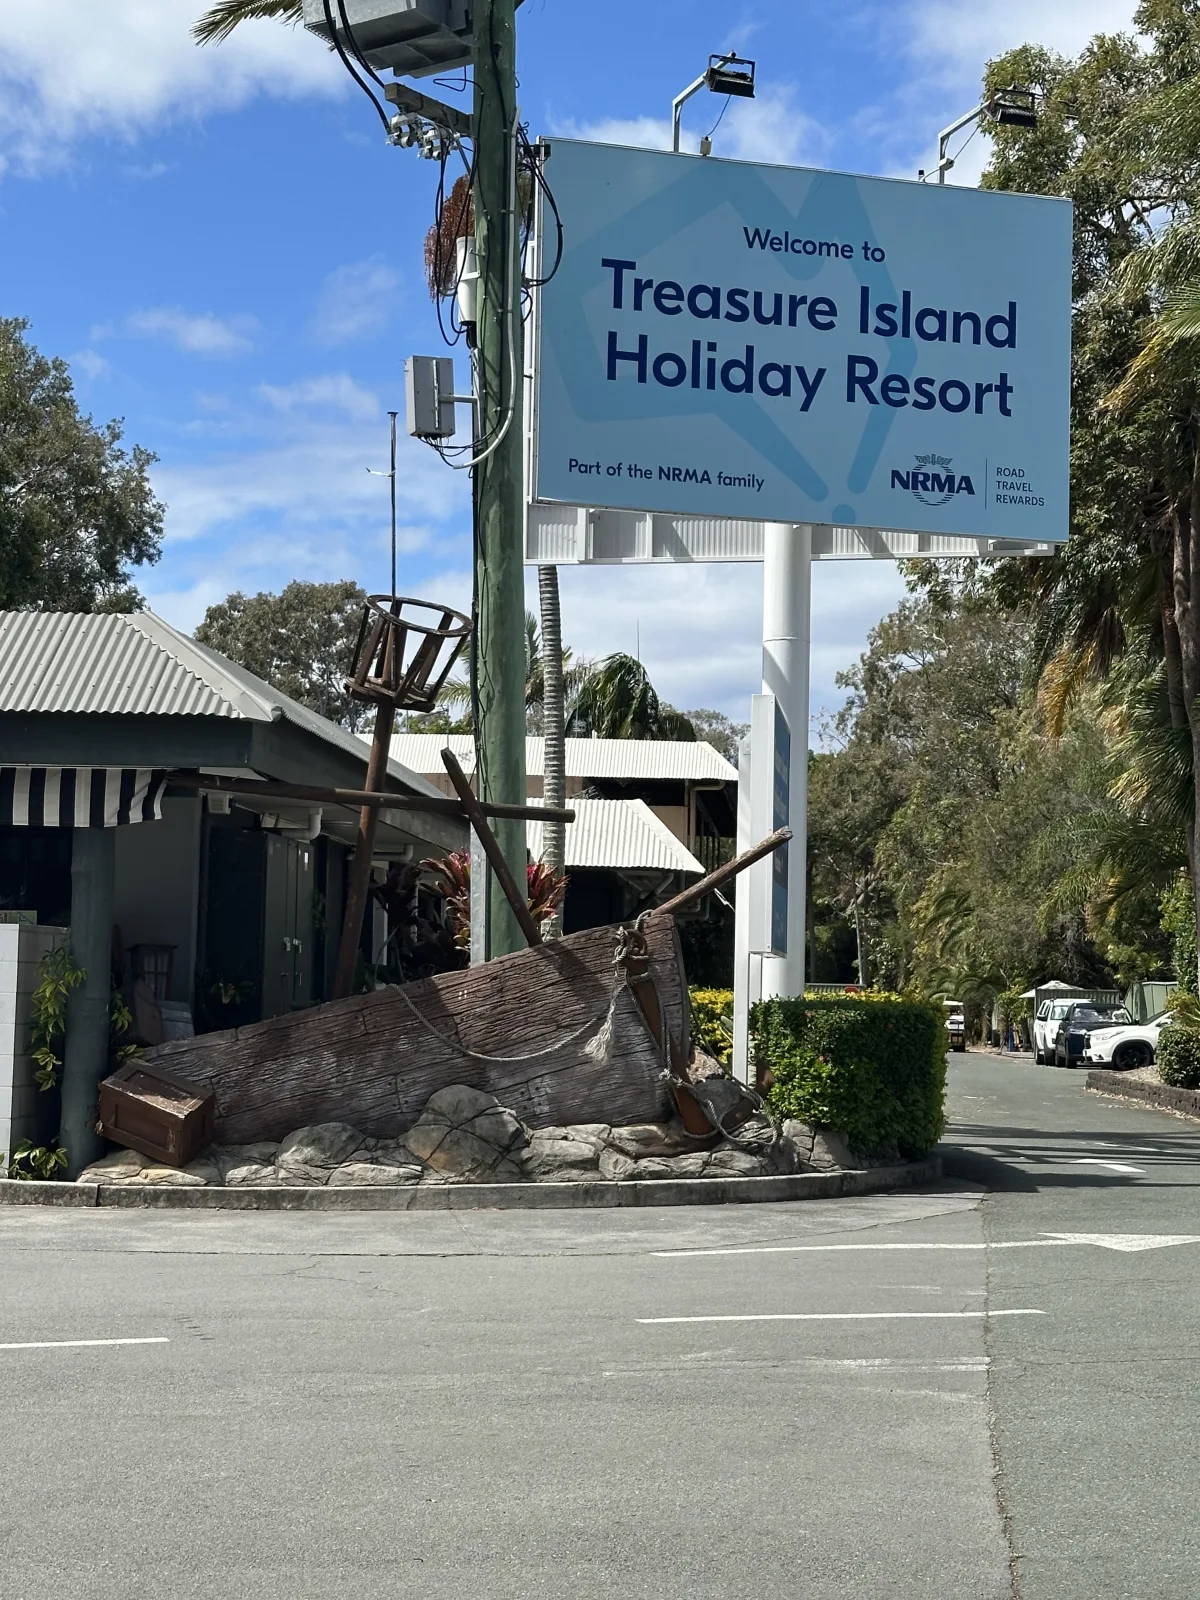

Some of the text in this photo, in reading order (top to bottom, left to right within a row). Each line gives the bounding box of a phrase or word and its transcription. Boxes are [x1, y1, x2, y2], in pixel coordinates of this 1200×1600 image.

[742, 226, 886, 263] Welcome to
[601, 257, 1017, 349] Treasure Island
[606, 330, 1014, 418] Holiday Resort
[568, 457, 765, 493] Part of the NRMA family
[890, 469, 976, 496] NRMA
[995, 480, 1034, 493] TRAVEL
[996, 466, 1025, 478] ROAD
[995, 493, 1045, 507] REWARDS
